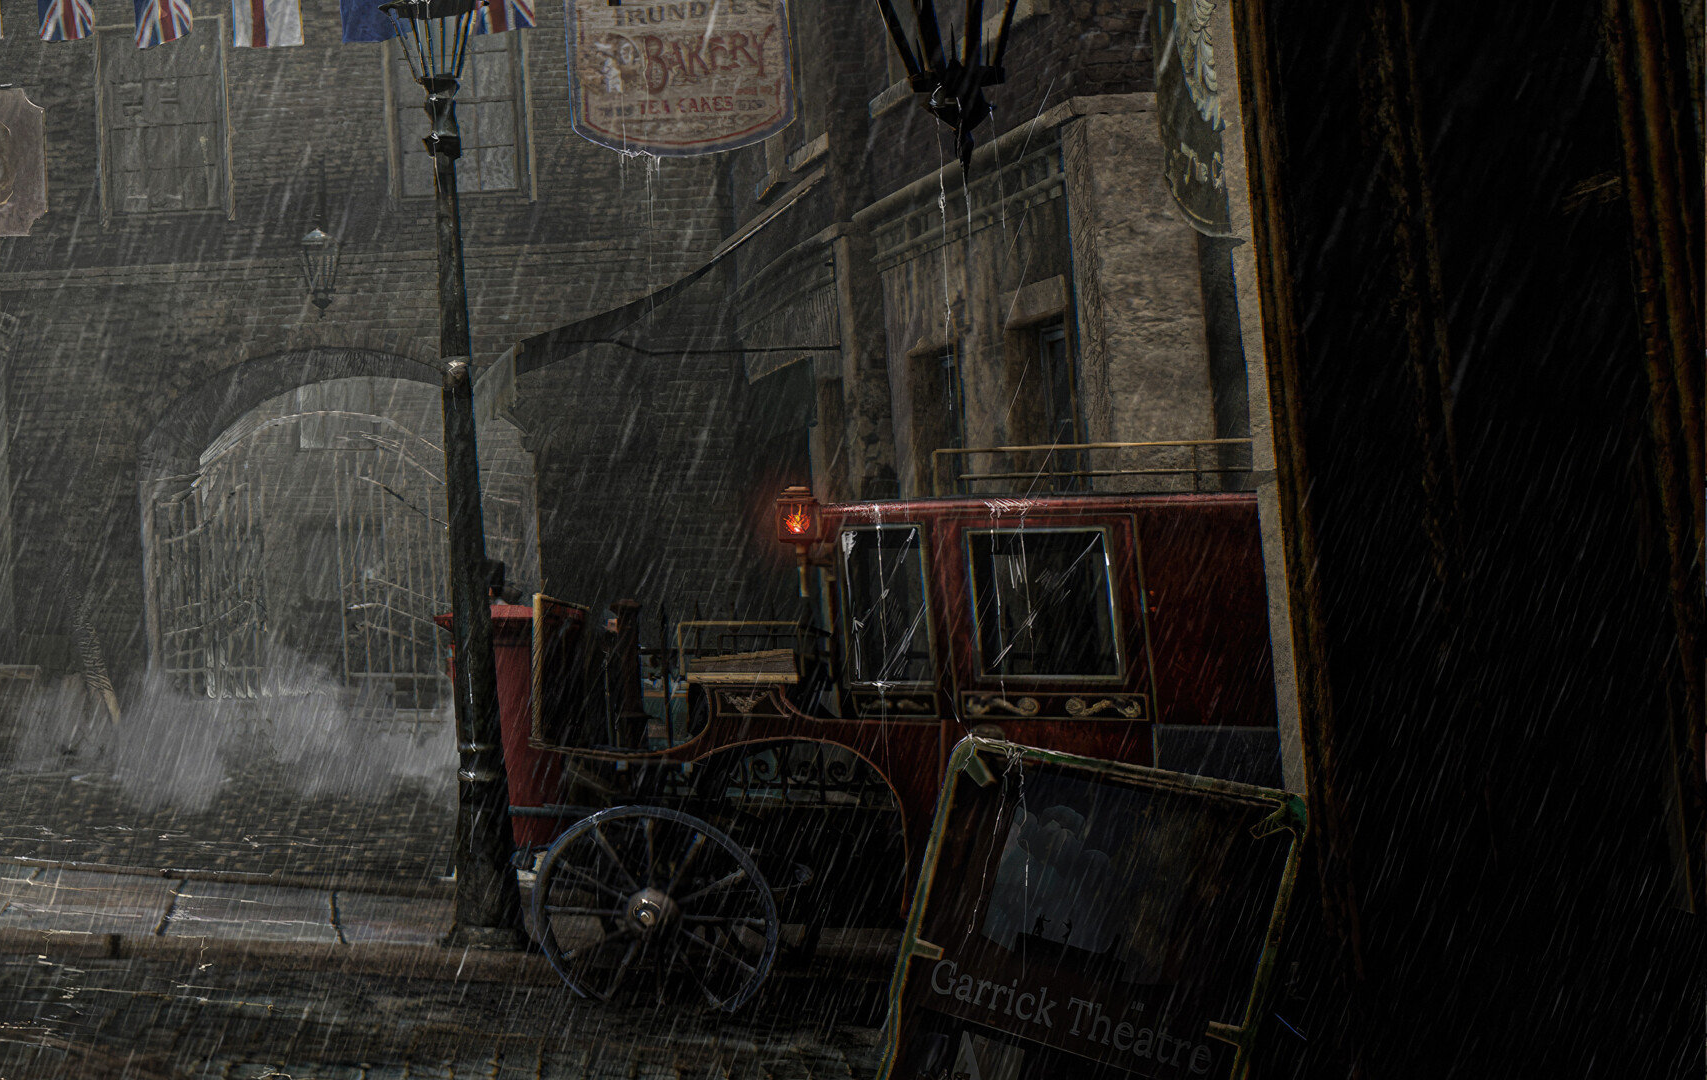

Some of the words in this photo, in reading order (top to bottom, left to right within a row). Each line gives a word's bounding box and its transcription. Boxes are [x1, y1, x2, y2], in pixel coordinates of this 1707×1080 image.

[644, 24, 776, 94] BAKERY
[930, 959, 1058, 1029] Garrick
[1067, 995, 1213, 1074] Theatre
